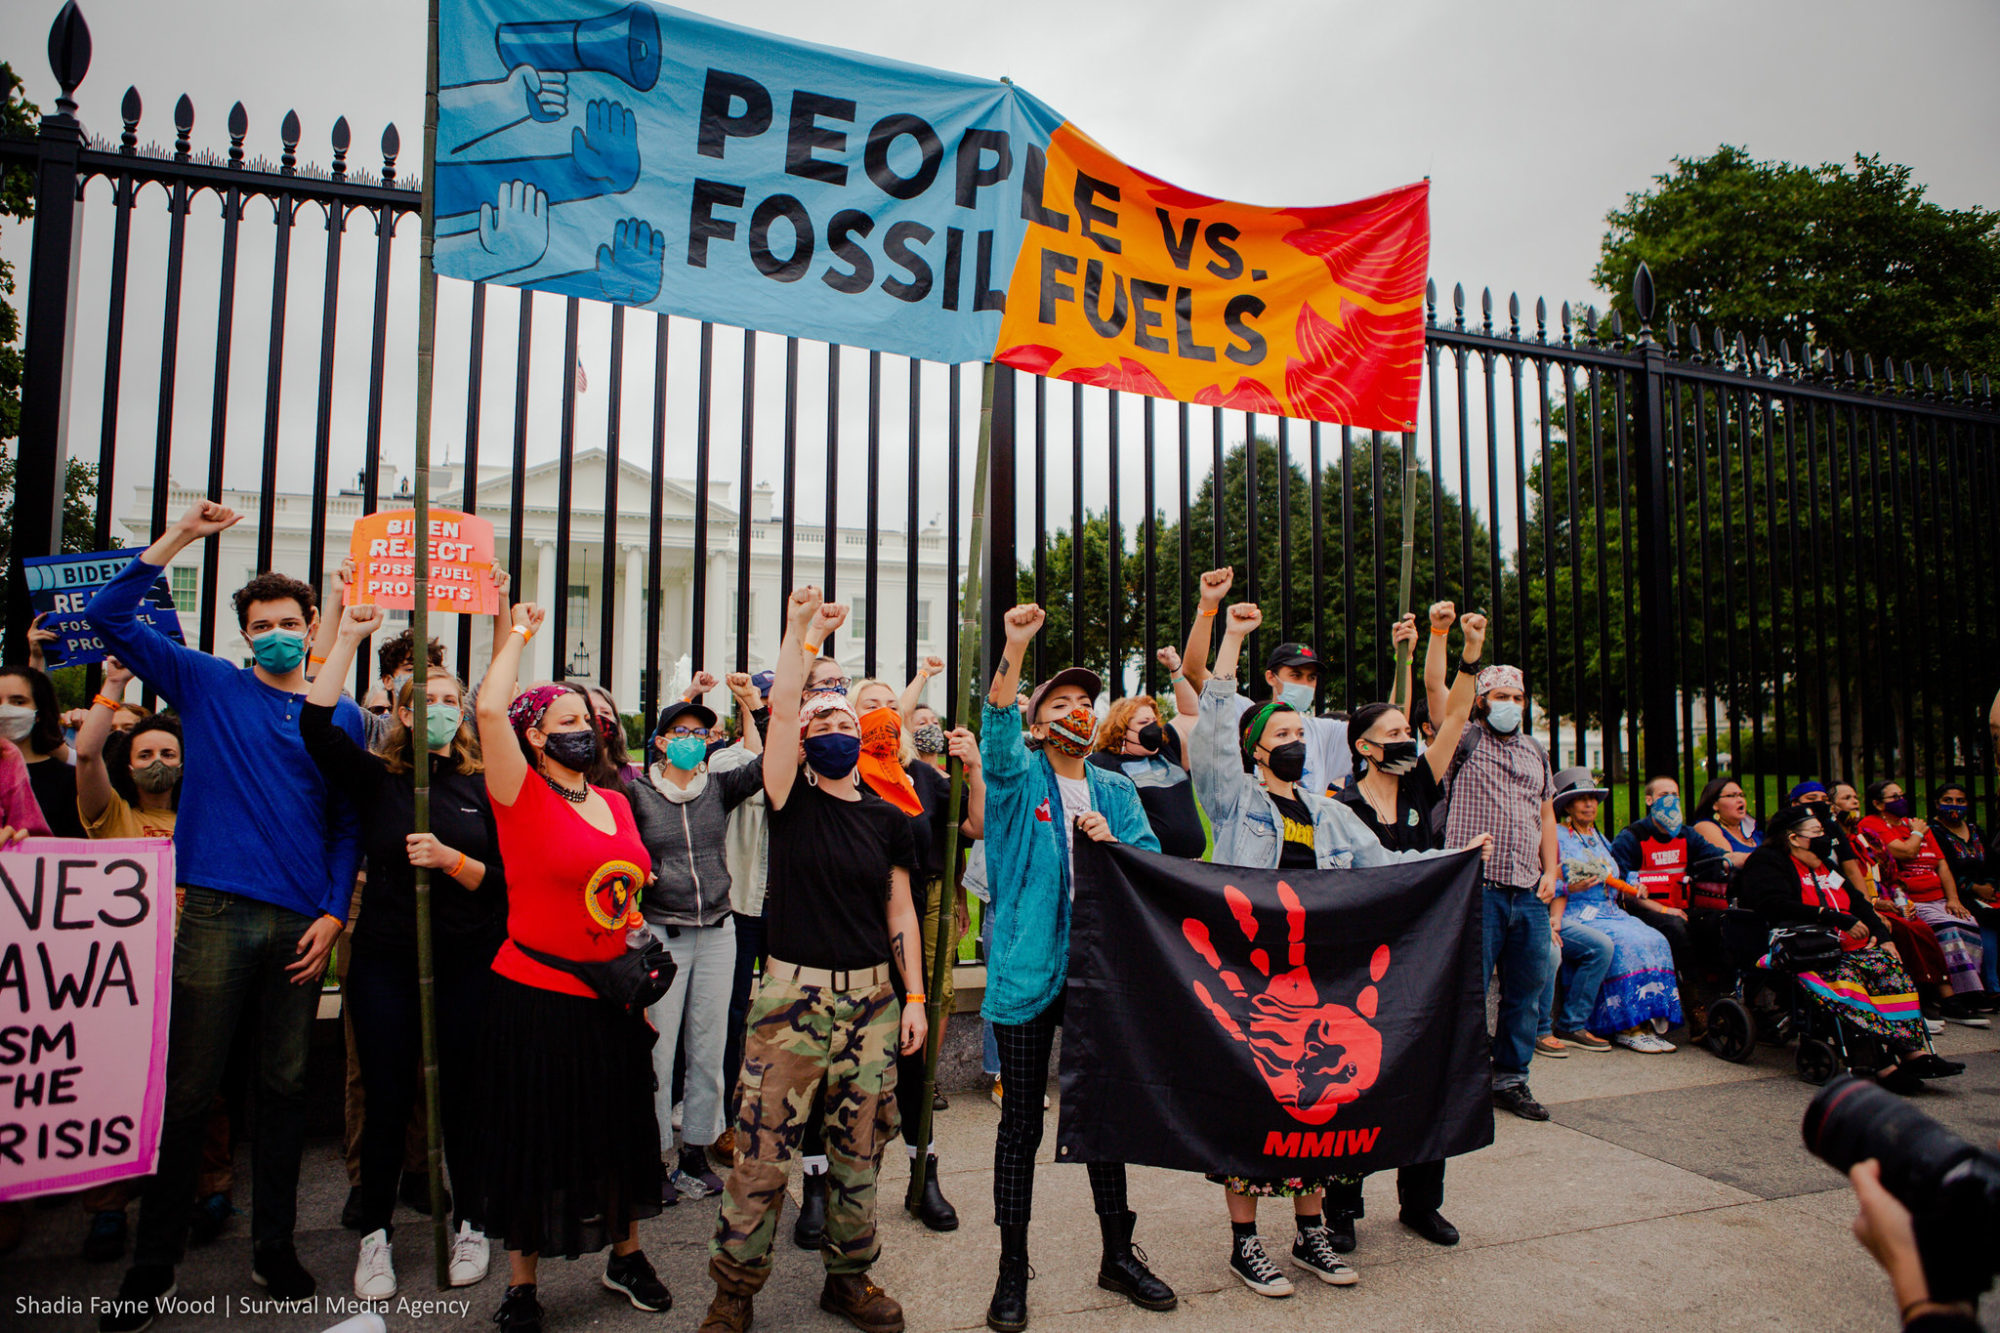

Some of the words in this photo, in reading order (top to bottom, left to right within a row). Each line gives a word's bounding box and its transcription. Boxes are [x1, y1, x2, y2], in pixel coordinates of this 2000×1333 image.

[697, 67, 1123, 255] PEOPLE
[1155, 207, 1269, 282] VS.
[687, 178, 1007, 316] FOSSIL
[1038, 248, 1268, 366] FUELS
[386, 519, 460, 539] BIEN
[369, 563, 414, 576] FOSS
[431, 567, 473, 581] FUEL
[1262, 1127, 1382, 1158] MMIW
